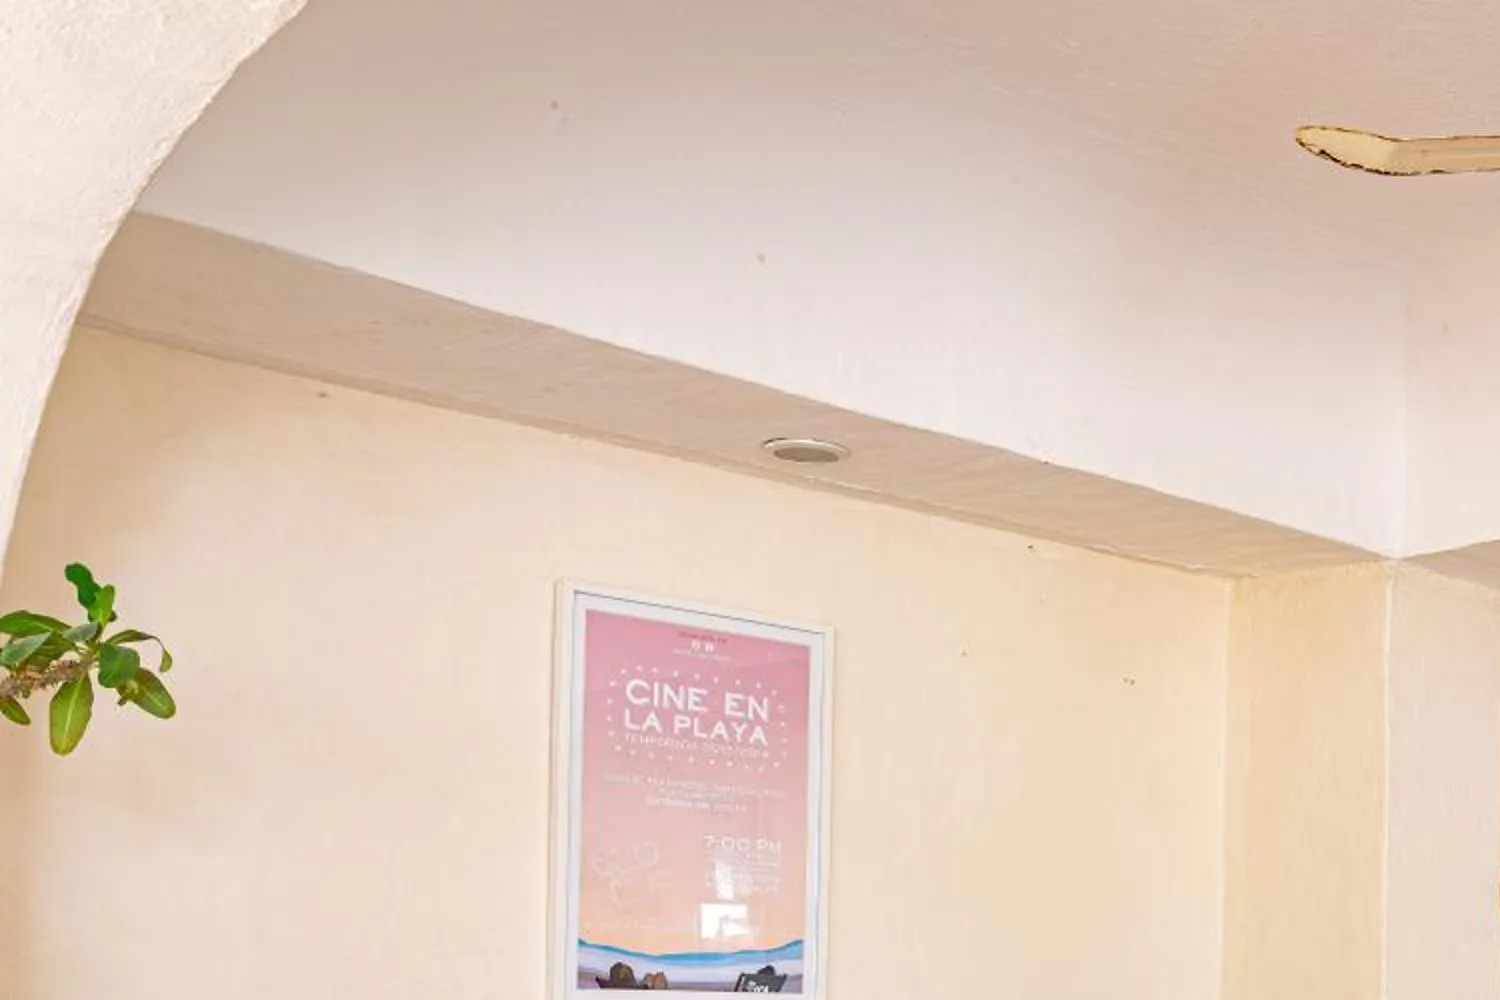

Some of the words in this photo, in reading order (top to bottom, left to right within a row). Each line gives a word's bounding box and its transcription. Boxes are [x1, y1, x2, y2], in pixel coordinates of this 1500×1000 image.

[625, 679, 708, 713] CINE
[724, 691, 769, 722] EN
[624, 708, 663, 733] LA
[673, 714, 769, 746] PLAYA
[757, 839, 782, 855] PM
